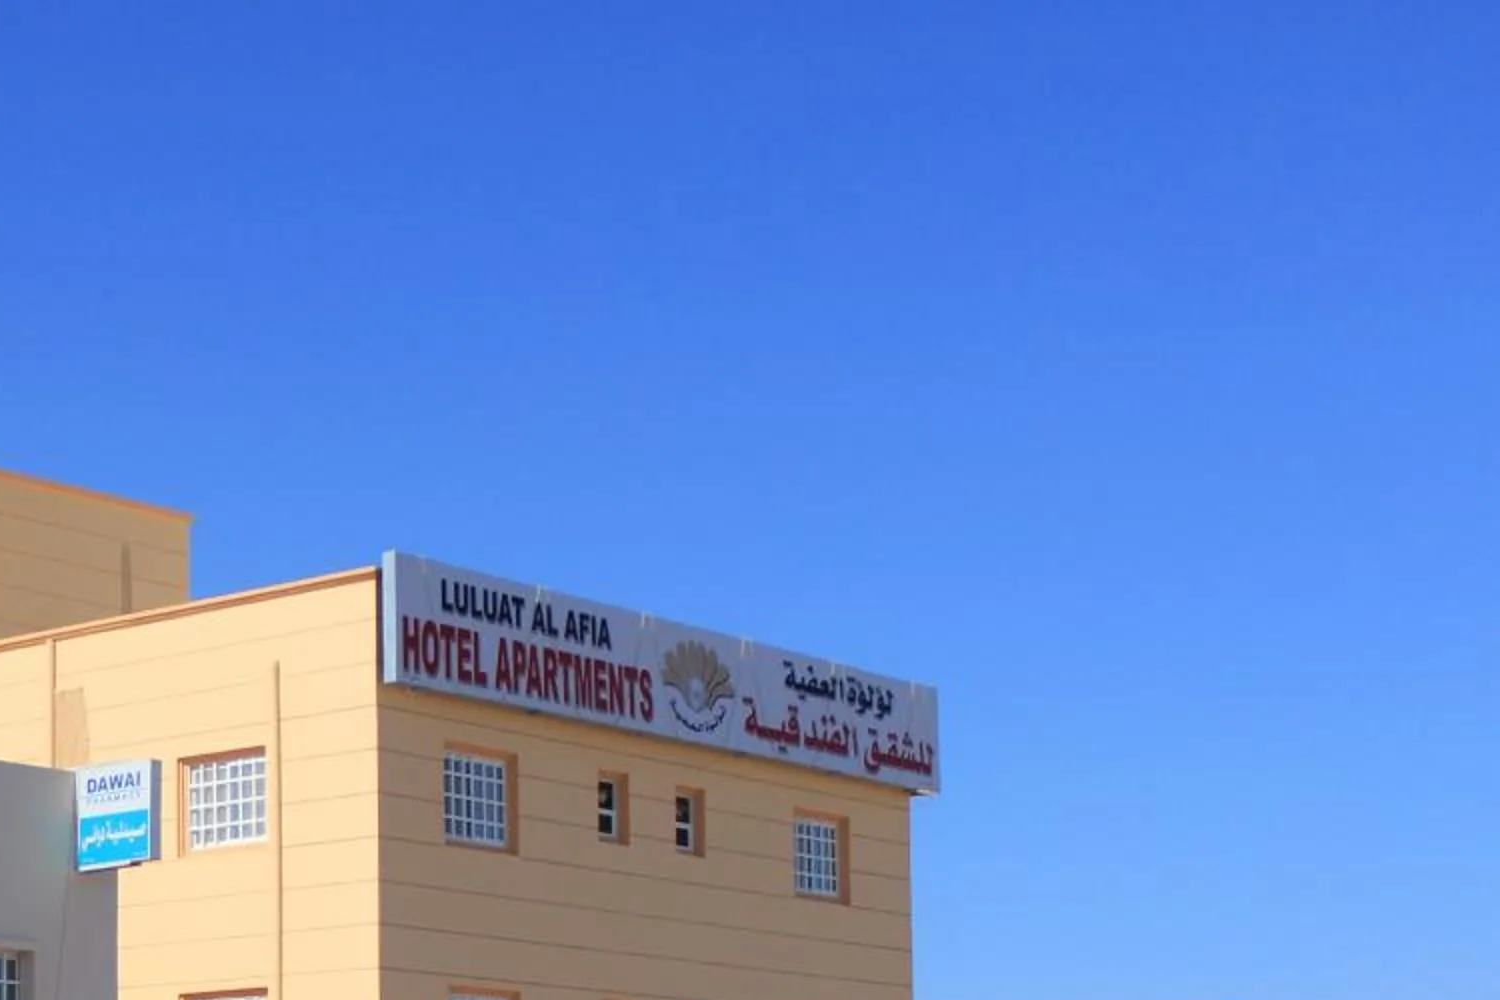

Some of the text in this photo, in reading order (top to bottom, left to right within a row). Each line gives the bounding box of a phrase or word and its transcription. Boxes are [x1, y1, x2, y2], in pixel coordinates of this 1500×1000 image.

[441, 578, 612, 651] LULUAT AL AFIA
[402, 615, 654, 723] HOTEL APARTMENTS
[740, 696, 934, 776] للشقق الفندقية
[87, 770, 141, 794] DAWAI
